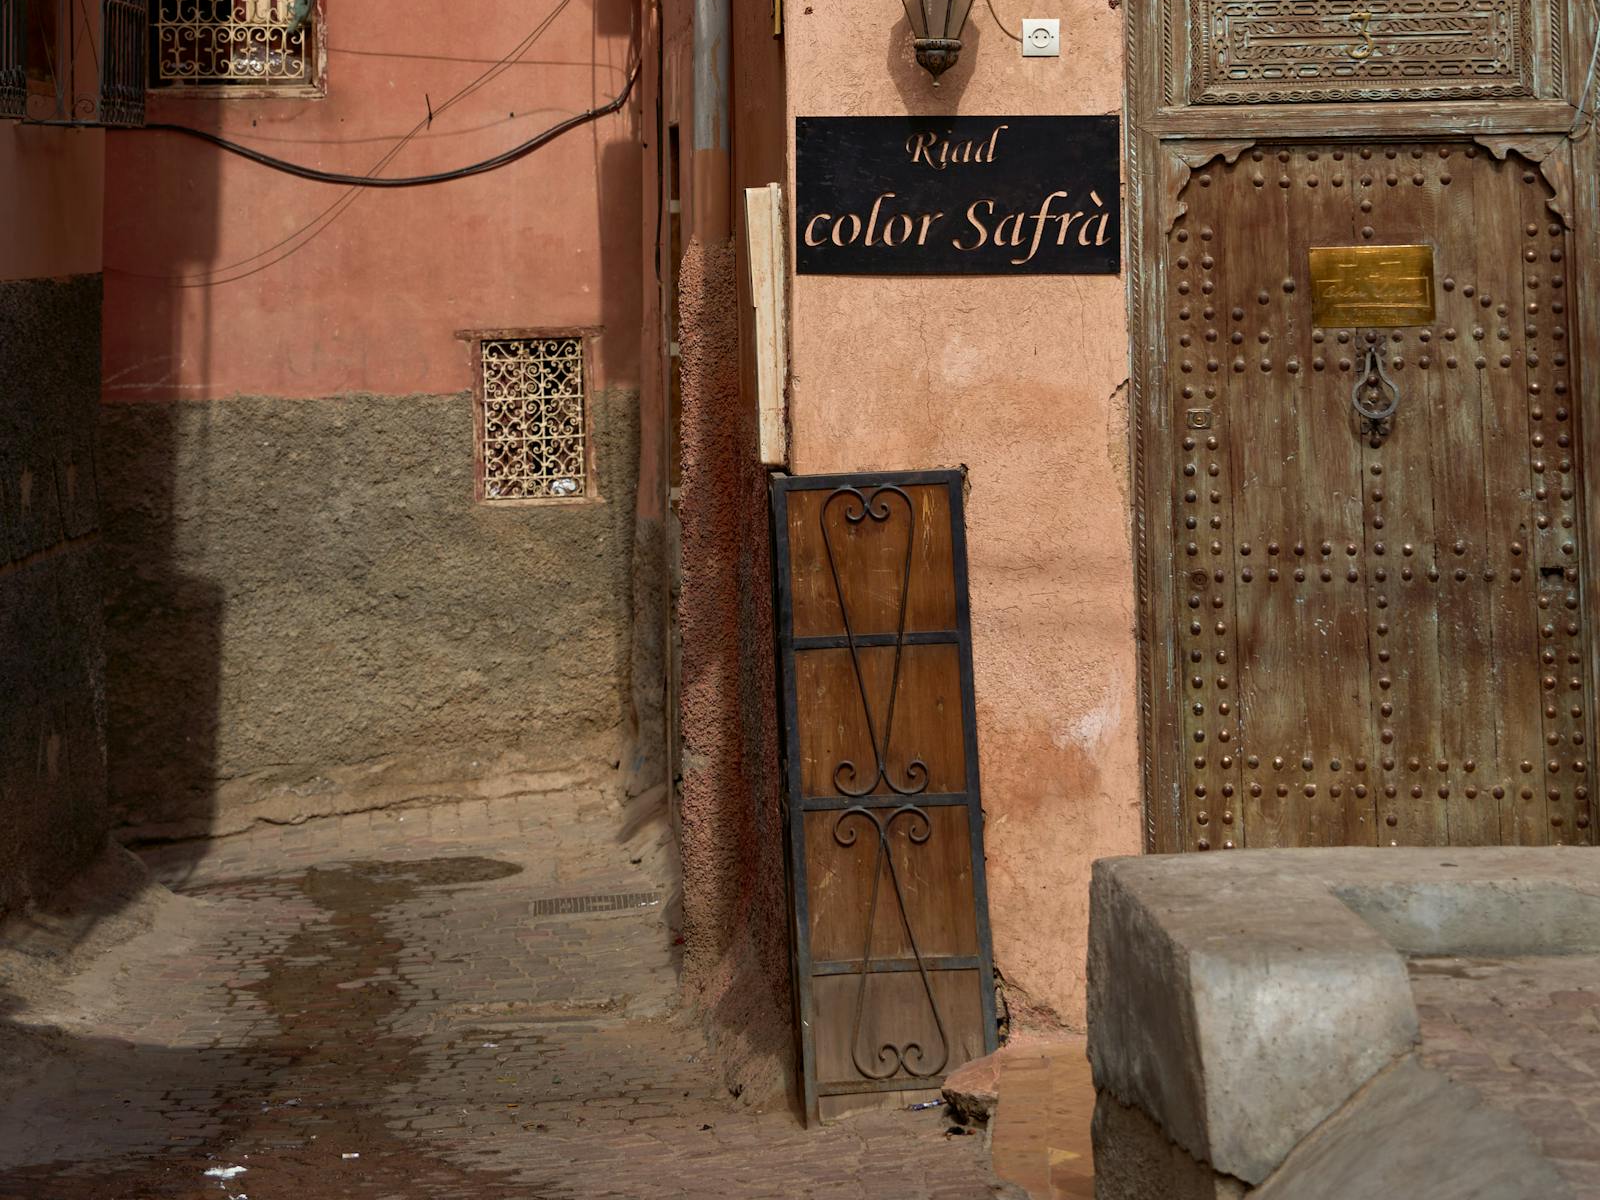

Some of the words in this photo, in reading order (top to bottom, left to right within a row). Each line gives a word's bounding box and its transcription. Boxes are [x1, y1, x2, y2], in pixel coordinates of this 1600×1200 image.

[1348, 12, 1374, 59] 3
[906, 125, 1008, 170] Riad
[804, 192, 944, 247] color
[952, 190, 1111, 265] Safrà
